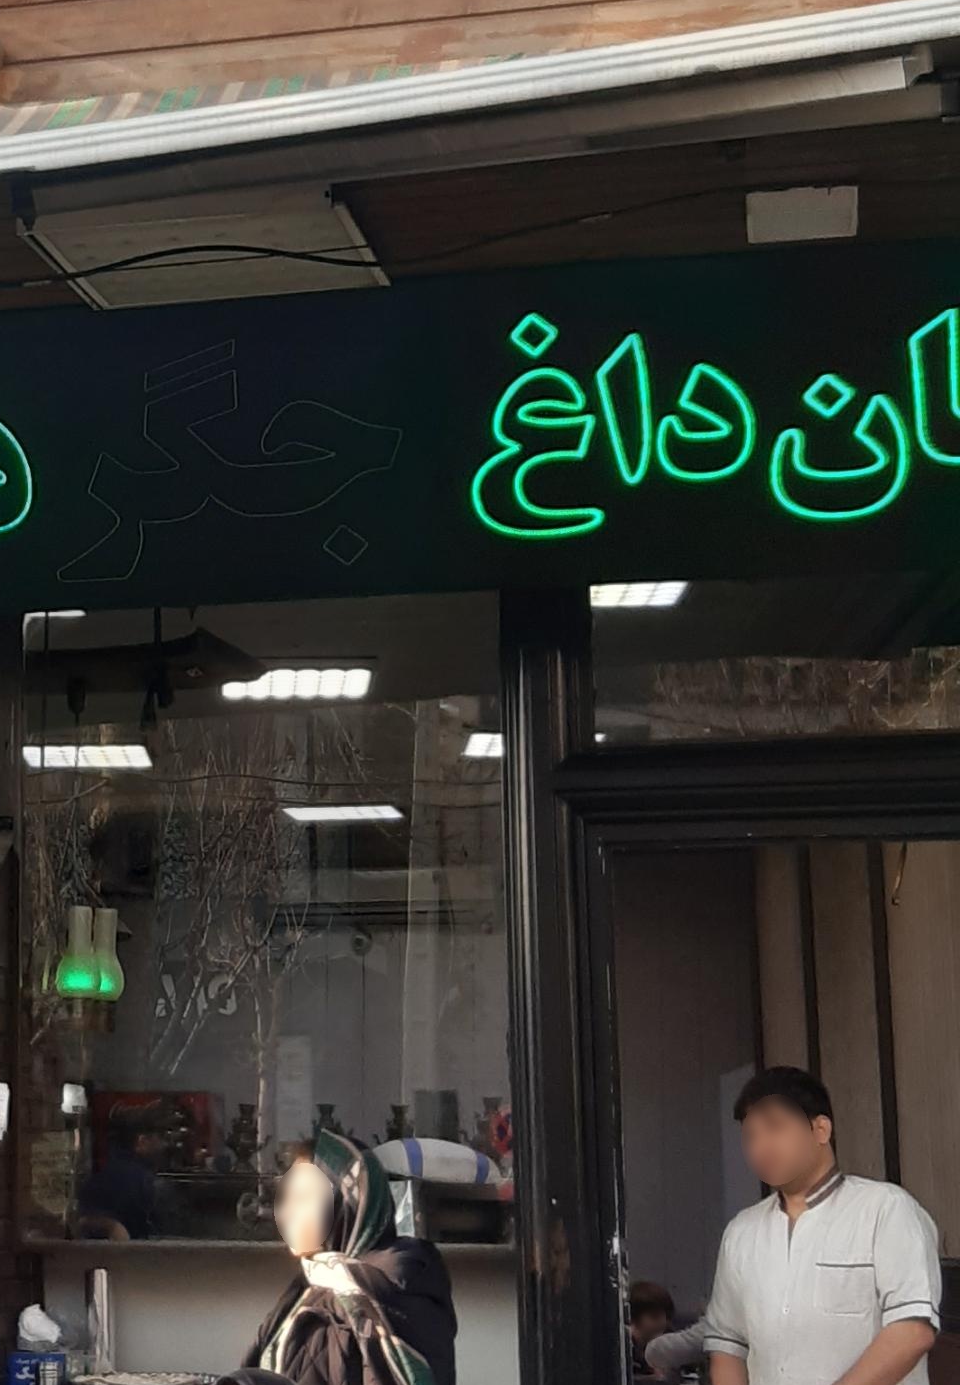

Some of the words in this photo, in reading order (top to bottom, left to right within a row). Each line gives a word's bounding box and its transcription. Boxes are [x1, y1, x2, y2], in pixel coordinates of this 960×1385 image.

[56, 338, 403, 583] جگر
[471, 311, 757, 538] داغ
[768, 307, 960, 522] ان
